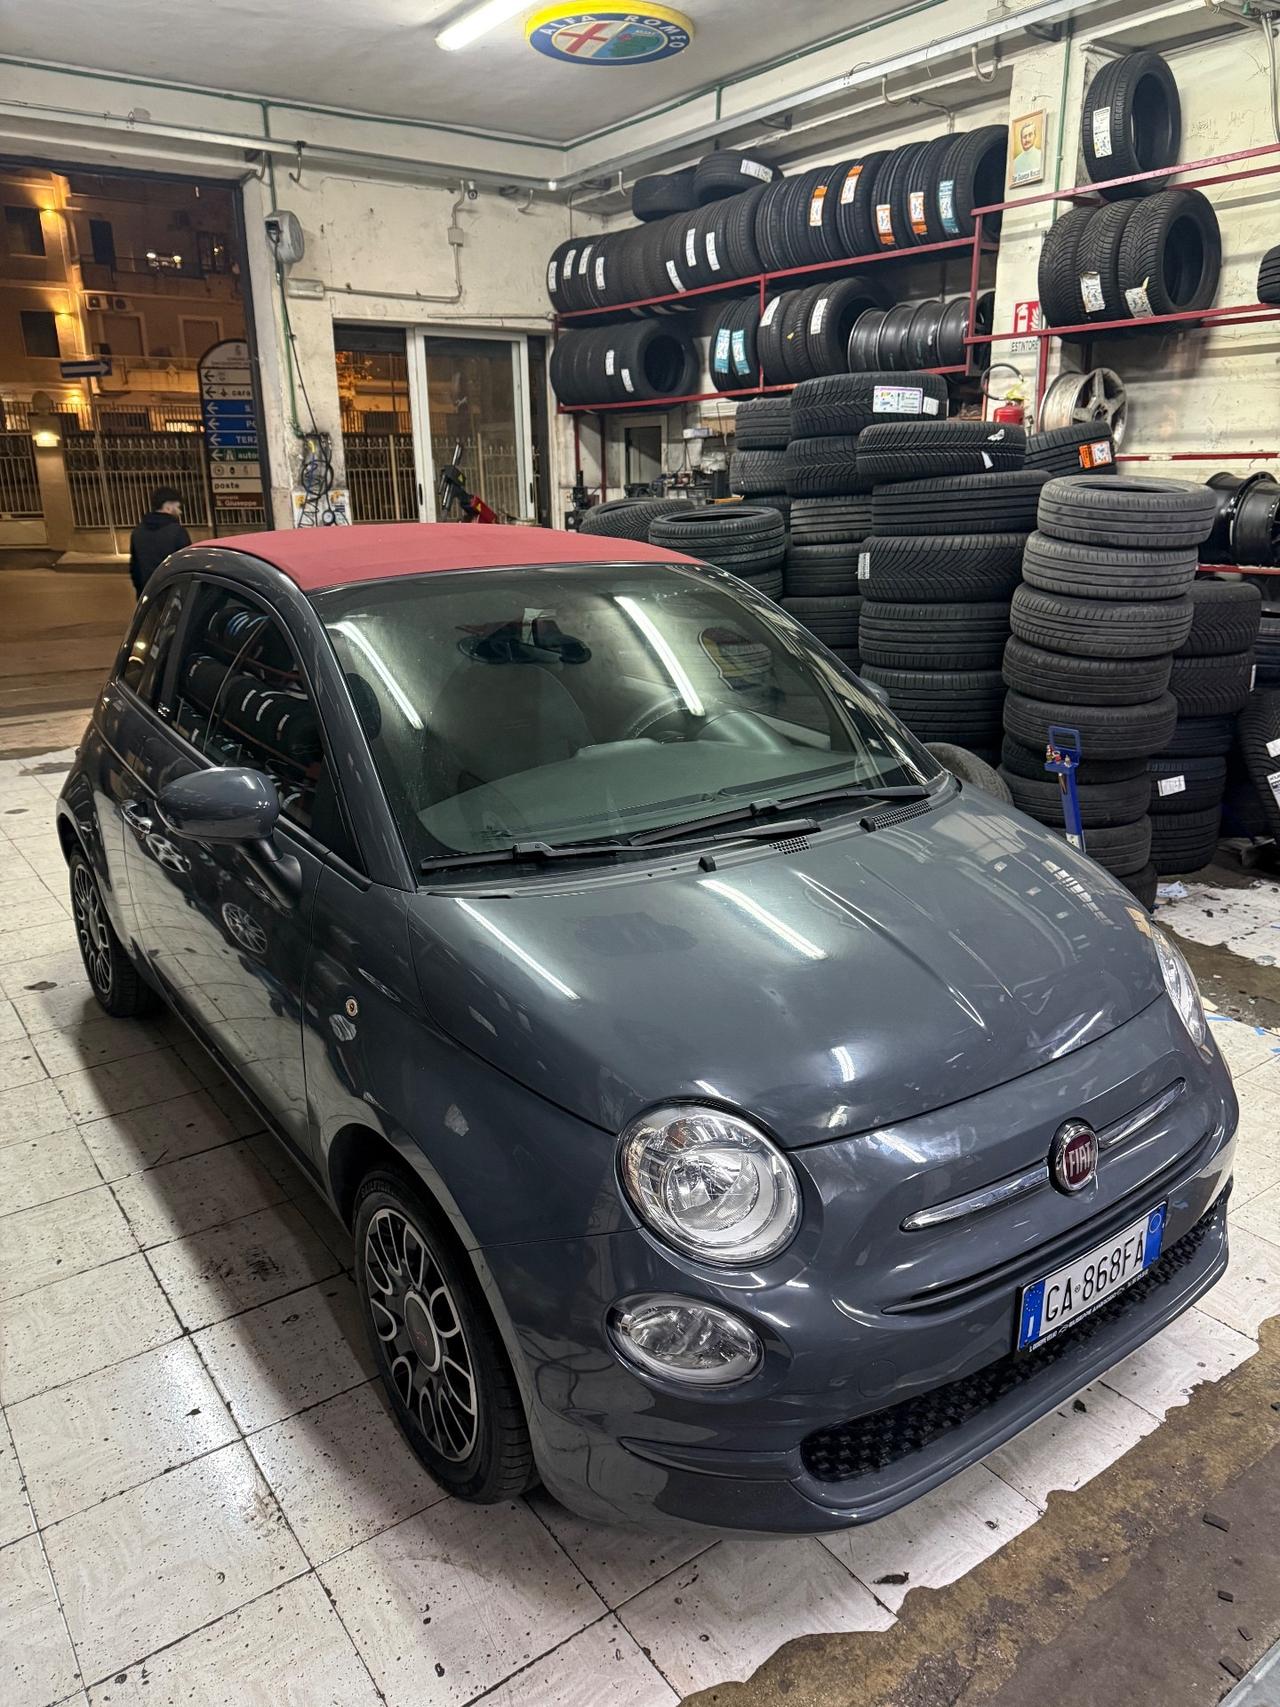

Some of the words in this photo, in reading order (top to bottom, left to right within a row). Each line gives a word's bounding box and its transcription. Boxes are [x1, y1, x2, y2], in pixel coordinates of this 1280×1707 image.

[539, 15, 596, 35] ALFA
[623, 14, 687, 48] ROMEO
[214, 482, 240, 490] poste
[225, 500, 257, 508] Giuseppe
[1068, 1141, 1091, 1178] FIAT
